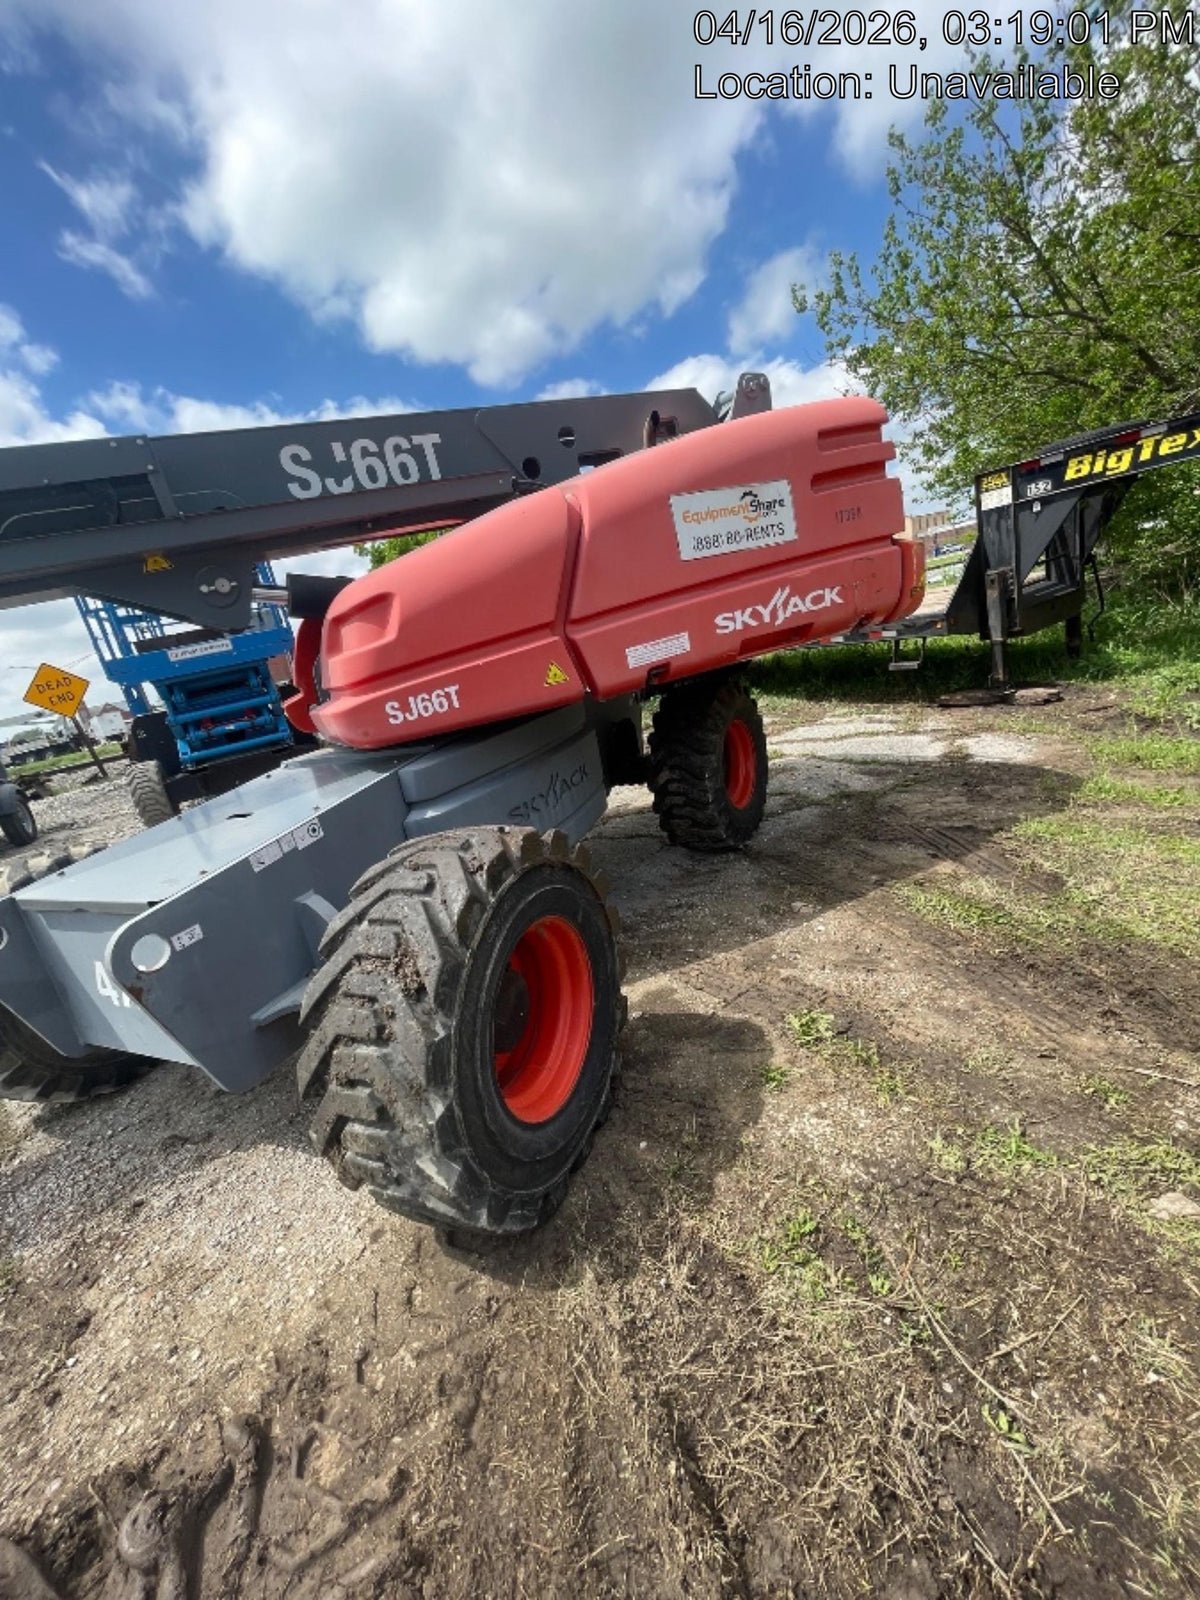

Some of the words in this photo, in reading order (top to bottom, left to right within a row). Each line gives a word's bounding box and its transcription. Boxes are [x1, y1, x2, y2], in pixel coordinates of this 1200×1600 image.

[279, 433, 441, 499] SJ66T
[714, 585, 844, 634] SKYJACK
[35, 676, 72, 694] DEAD
[48, 690, 75, 706] END
[385, 685, 460, 725] SJ66T
